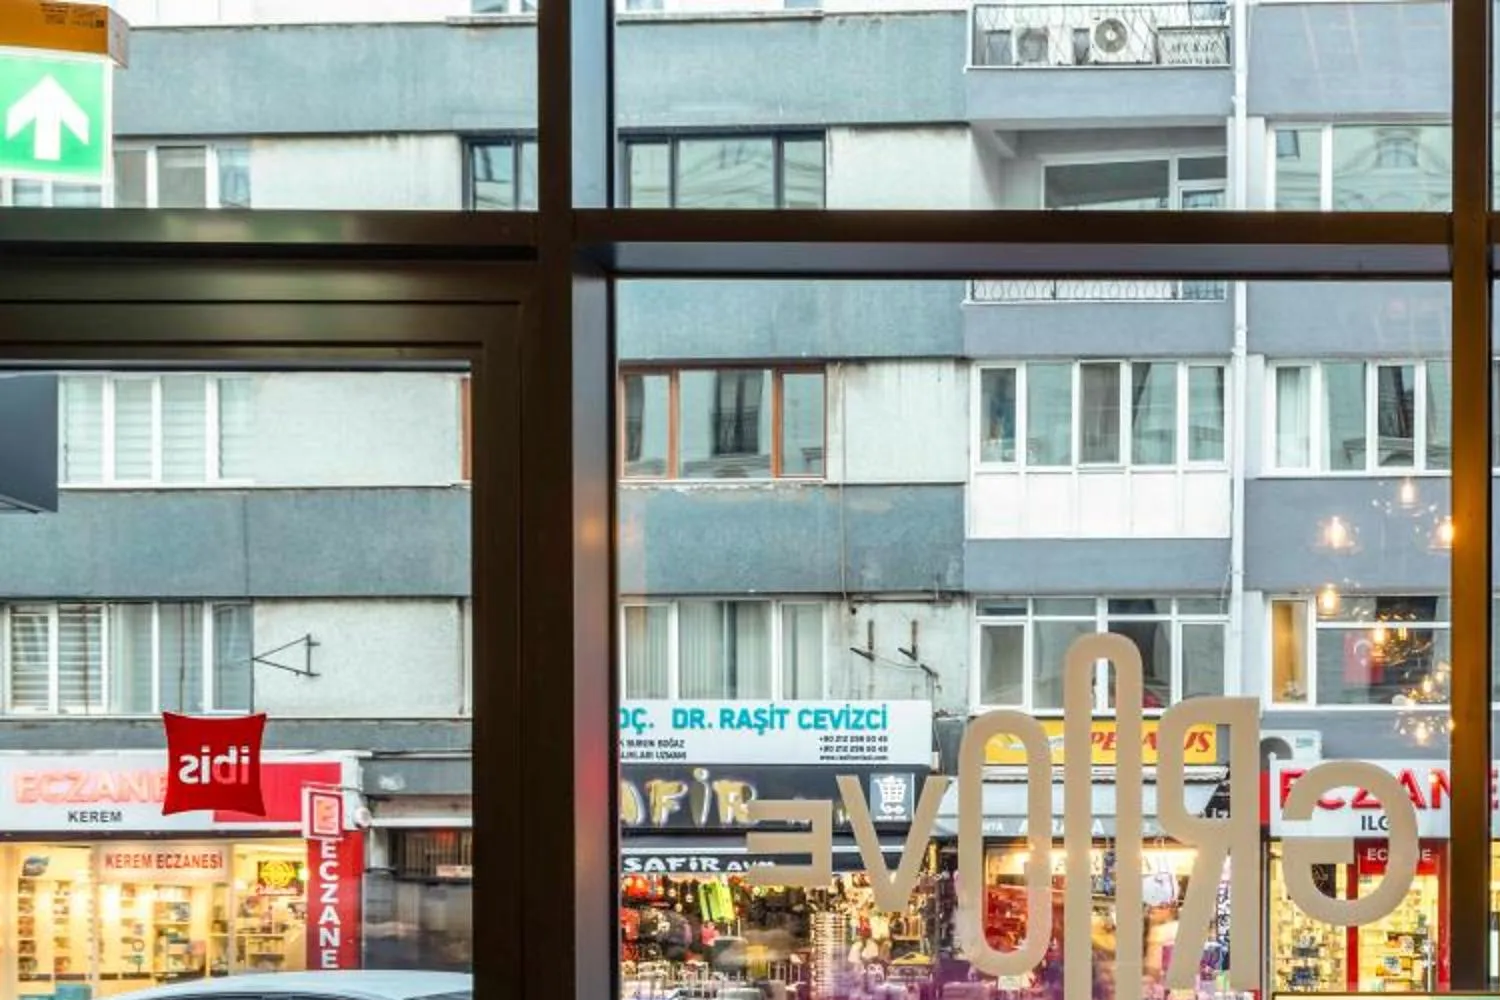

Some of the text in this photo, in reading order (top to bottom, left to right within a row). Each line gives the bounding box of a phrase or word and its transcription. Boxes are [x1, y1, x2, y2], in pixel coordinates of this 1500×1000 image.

[672, 708, 713, 730] DR.
[719, 703, 790, 736] RAŞİT
[797, 703, 889, 731] CEVİZCİ
[67, 810, 123, 823] KEREM
[105, 850, 223, 870] KEREM ECZANESİ
[623, 856, 721, 872] SAFİR
[1366, 848, 1431, 862] ECE
[319, 840, 341, 970] ECZANE
